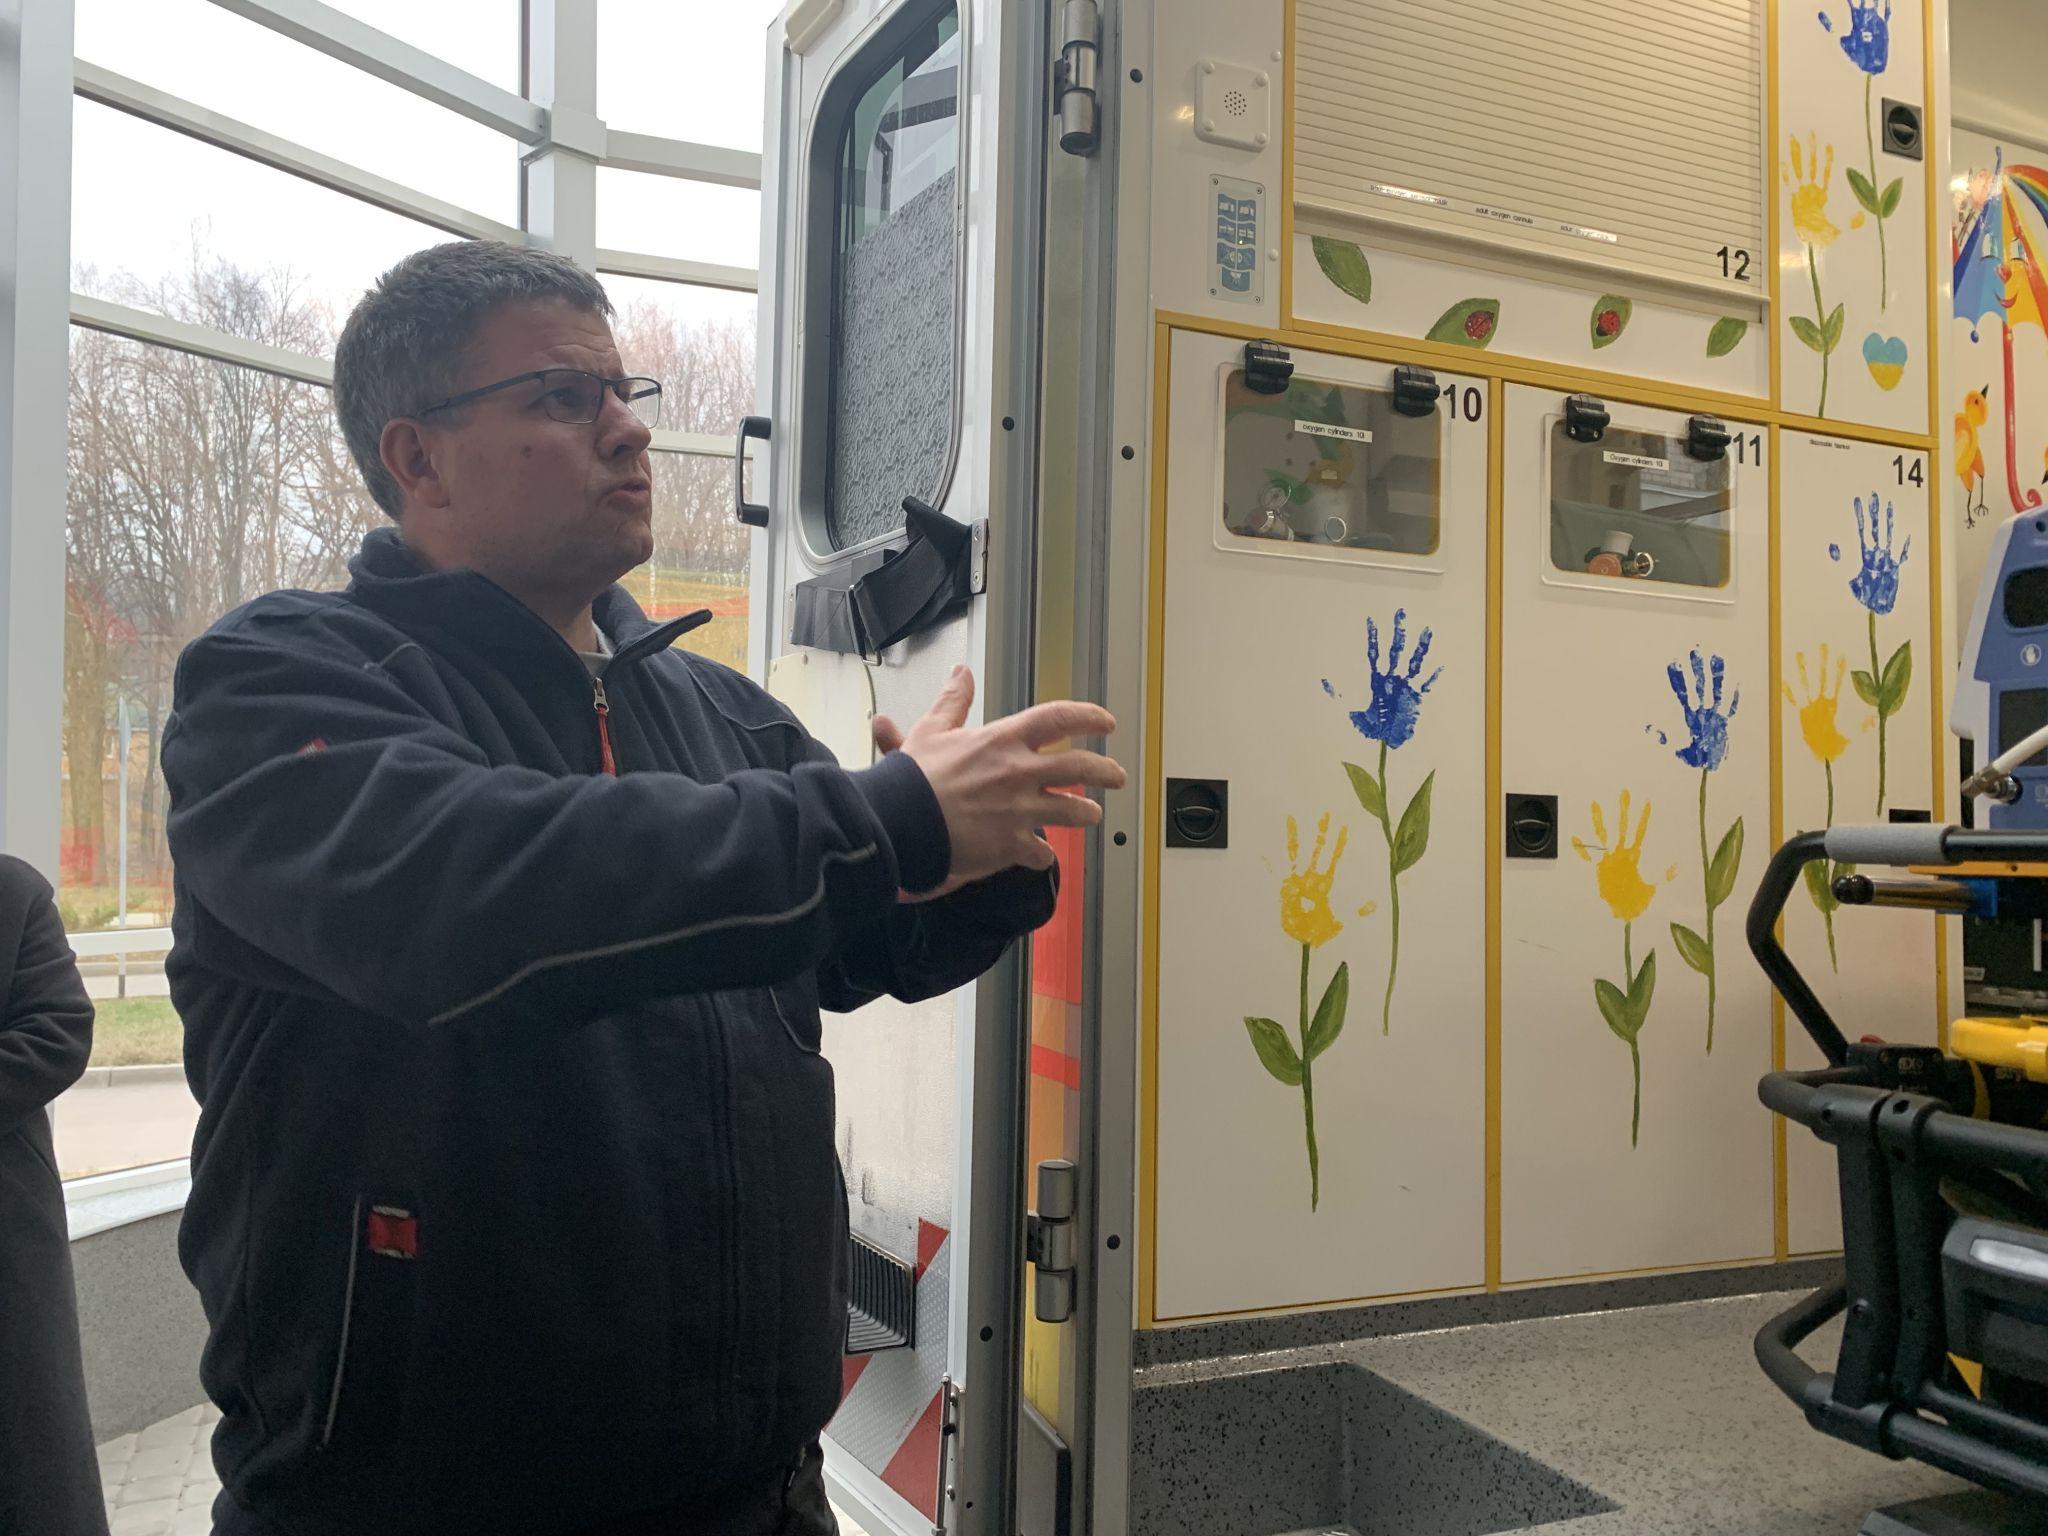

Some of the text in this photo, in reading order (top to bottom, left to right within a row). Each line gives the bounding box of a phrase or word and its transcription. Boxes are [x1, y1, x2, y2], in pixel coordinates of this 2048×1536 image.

[1490, 210, 1511, 219] oxygen
[1717, 246, 1750, 282] 12
[1442, 383, 1482, 423] 10
[1302, 424, 1326, 433] oxygen
[1327, 427, 1353, 438] cylinders
[1609, 453, 1631, 463] Oxygen
[1632, 457, 1654, 466] cylinders
[1732, 431, 1761, 467] 11
[1892, 454, 1924, 488] 14
